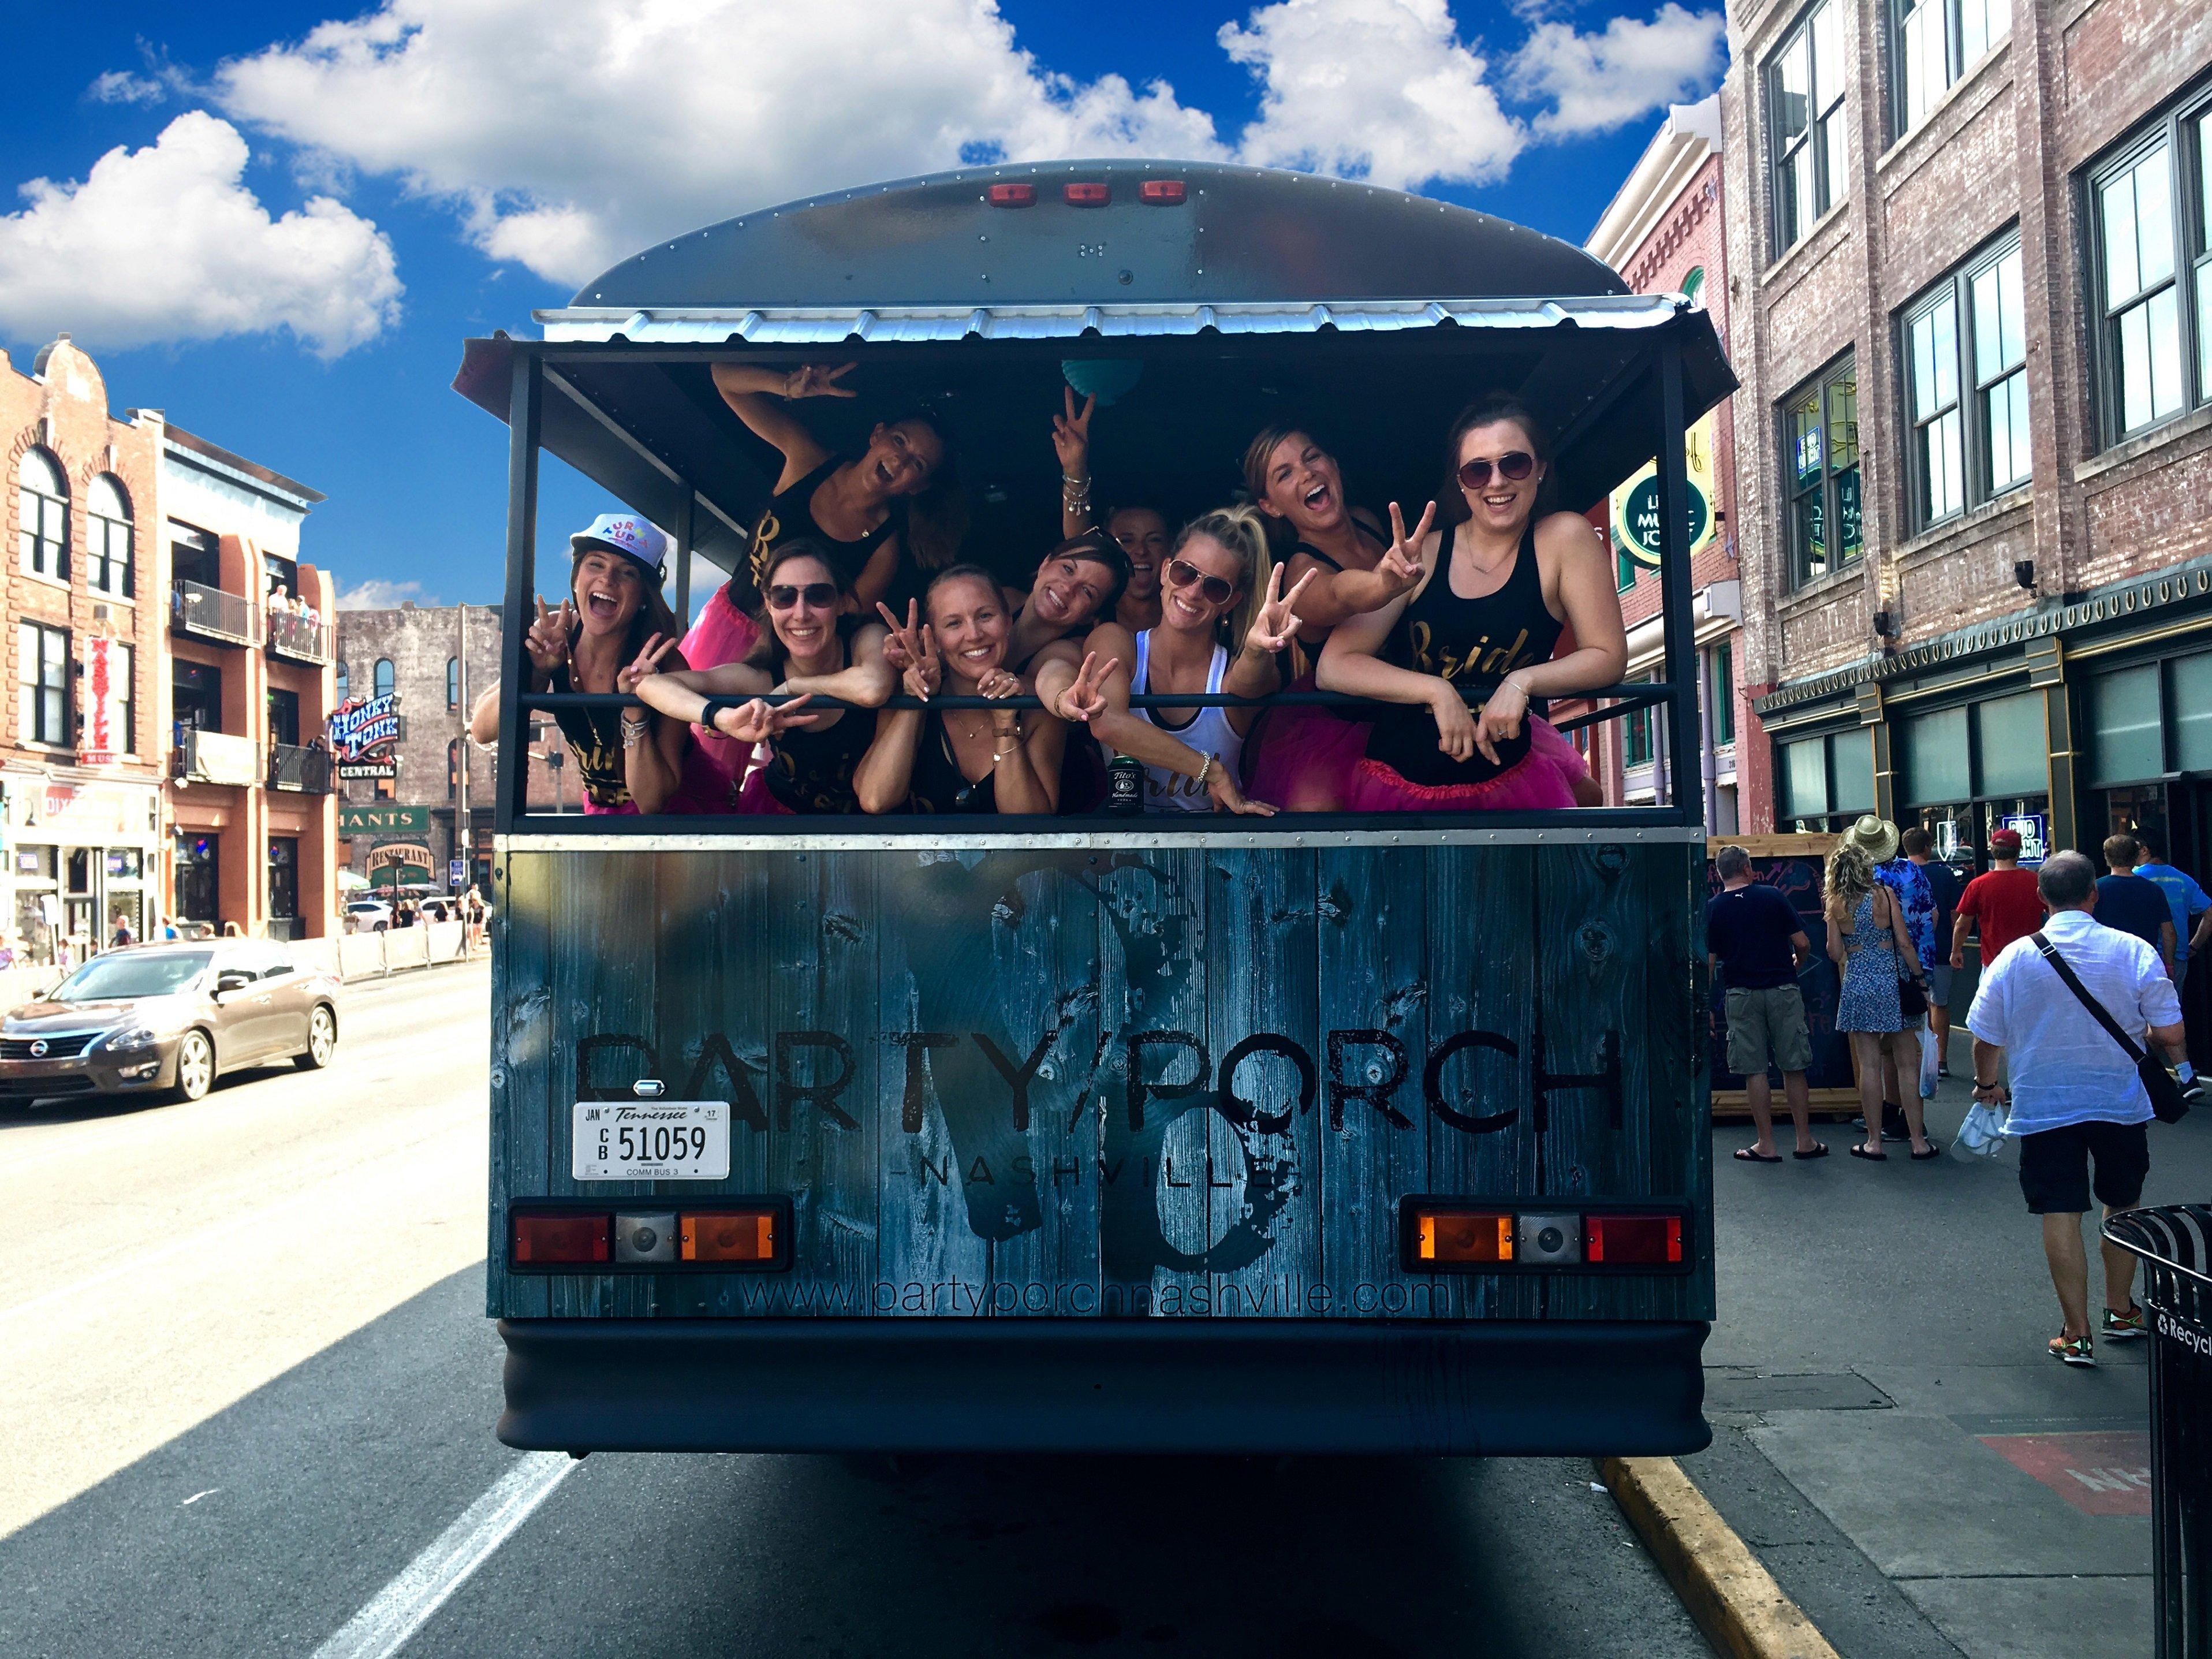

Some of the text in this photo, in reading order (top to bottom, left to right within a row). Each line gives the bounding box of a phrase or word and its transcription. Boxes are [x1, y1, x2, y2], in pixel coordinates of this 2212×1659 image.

[615, 530, 635, 542] UP
[333, 694, 394, 740] HONKY
[345, 718, 398, 759] TONK
[87, 754, 113, 763] MUS
[340, 766, 394, 777] CENTRAL
[1114, 771, 1136, 780] Tito's
[585, 1109, 600, 1121] JAN
[616, 1107, 688, 1123] Tennessee
[619, 1126, 706, 1161] 51059
[741, 1273, 1449, 1317] www.partyporchnashville.com
